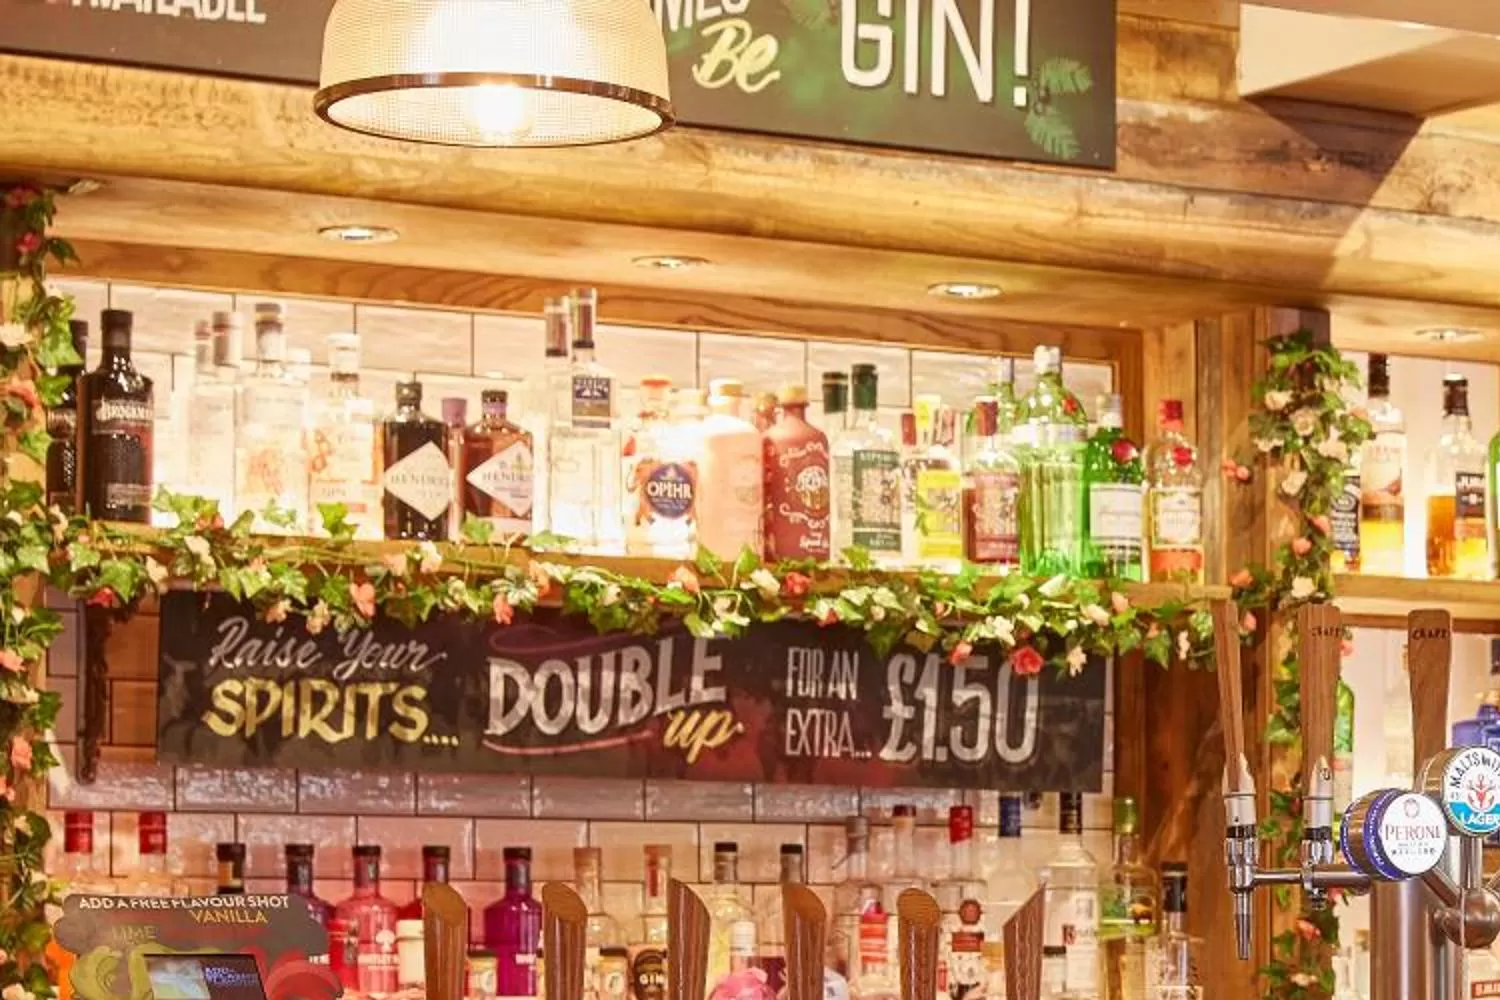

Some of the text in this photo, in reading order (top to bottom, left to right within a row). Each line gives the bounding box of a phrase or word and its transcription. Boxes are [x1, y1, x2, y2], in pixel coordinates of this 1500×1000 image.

[691, 17, 782, 94] Be
[841, 0, 1029, 108] GIN!
[208, 616, 448, 681] Raise Your
[786, 646, 860, 700] FOR AN
[484, 635, 727, 737] DOUBLE
[878, 652, 1041, 765] £1.50
[1385, 824, 1441, 841] PERONI
[79, 895, 289, 910] ADD A FREE FLAVOUR SHOT
[112, 924, 158, 940] LIME
[189, 909, 269, 924] VANILLA
